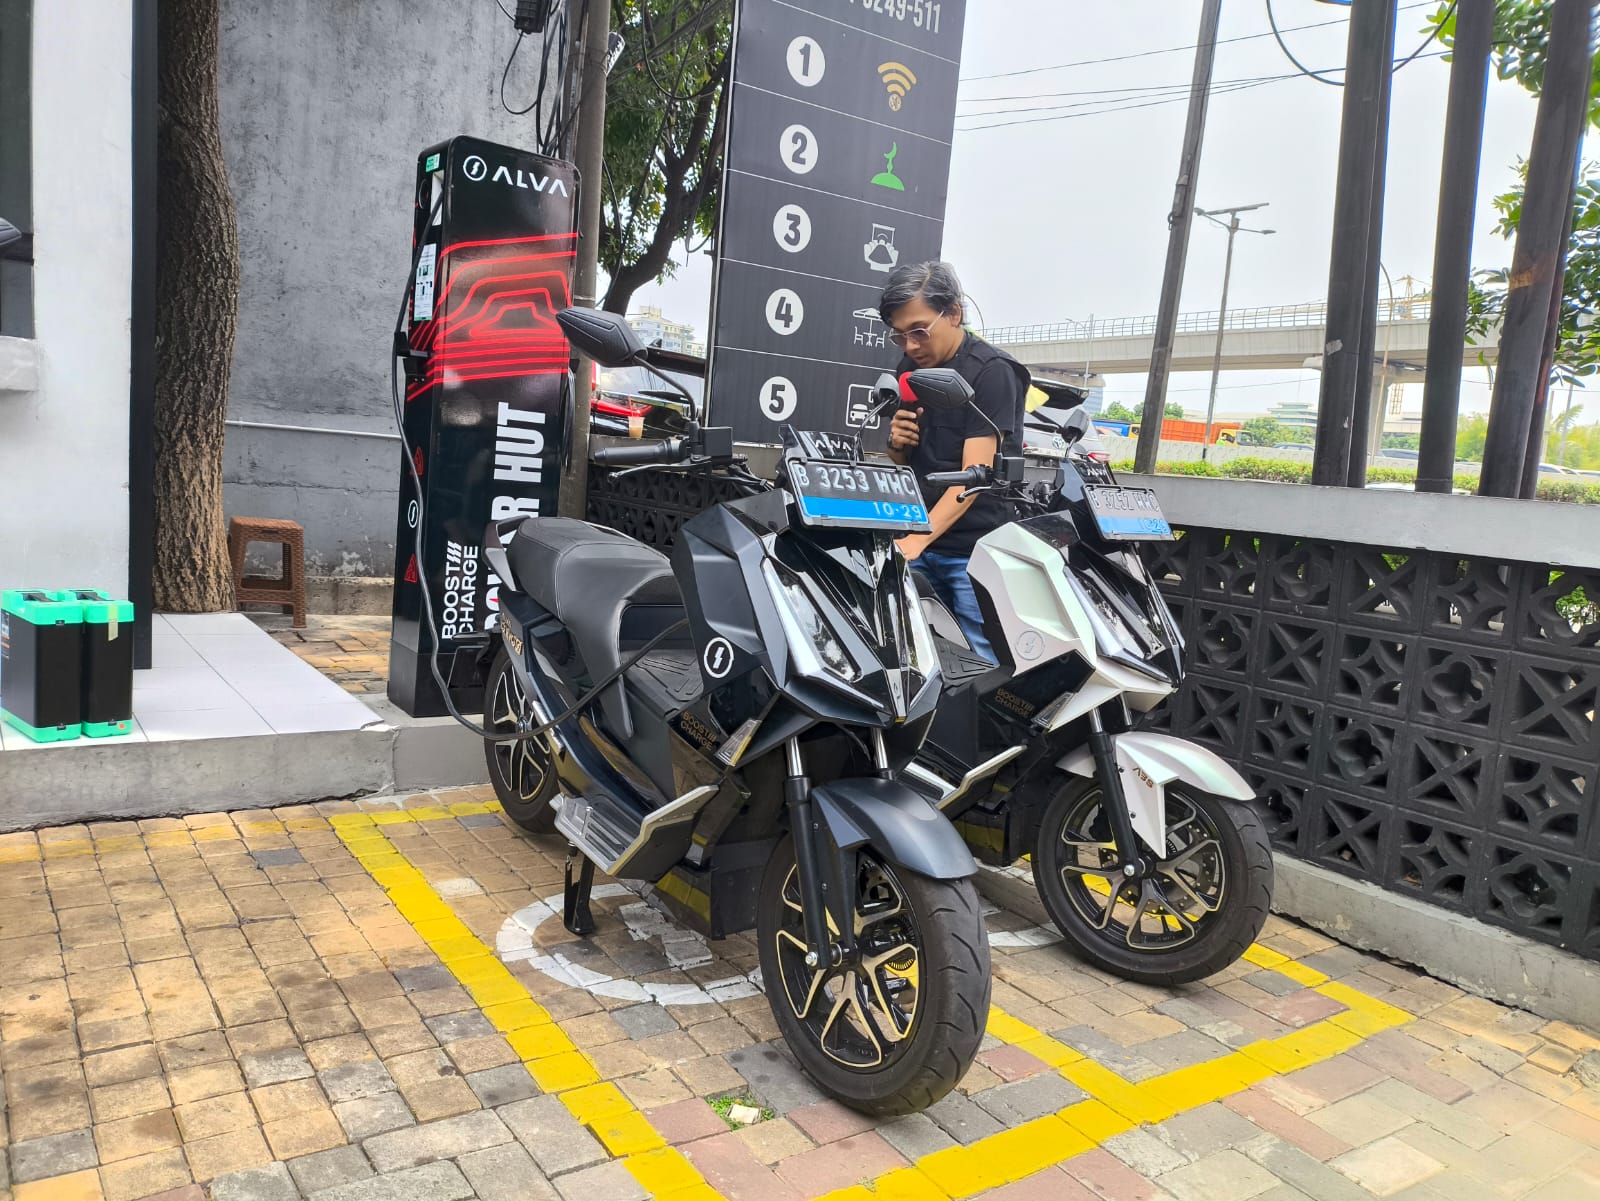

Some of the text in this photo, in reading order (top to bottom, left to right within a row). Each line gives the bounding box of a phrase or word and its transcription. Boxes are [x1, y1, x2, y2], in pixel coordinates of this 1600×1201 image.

[799, 43, 811, 77] 1
[791, 131, 808, 165] 2
[492, 165, 568, 198] ALVA
[783, 212, 801, 247] 3
[774, 296, 793, 328] 4
[768, 383, 786, 414] 5
[493, 401, 546, 483] HUT
[793, 464, 810, 487] B
[816, 466, 870, 493] 3253
[680, 720, 713, 750] CHARGE
